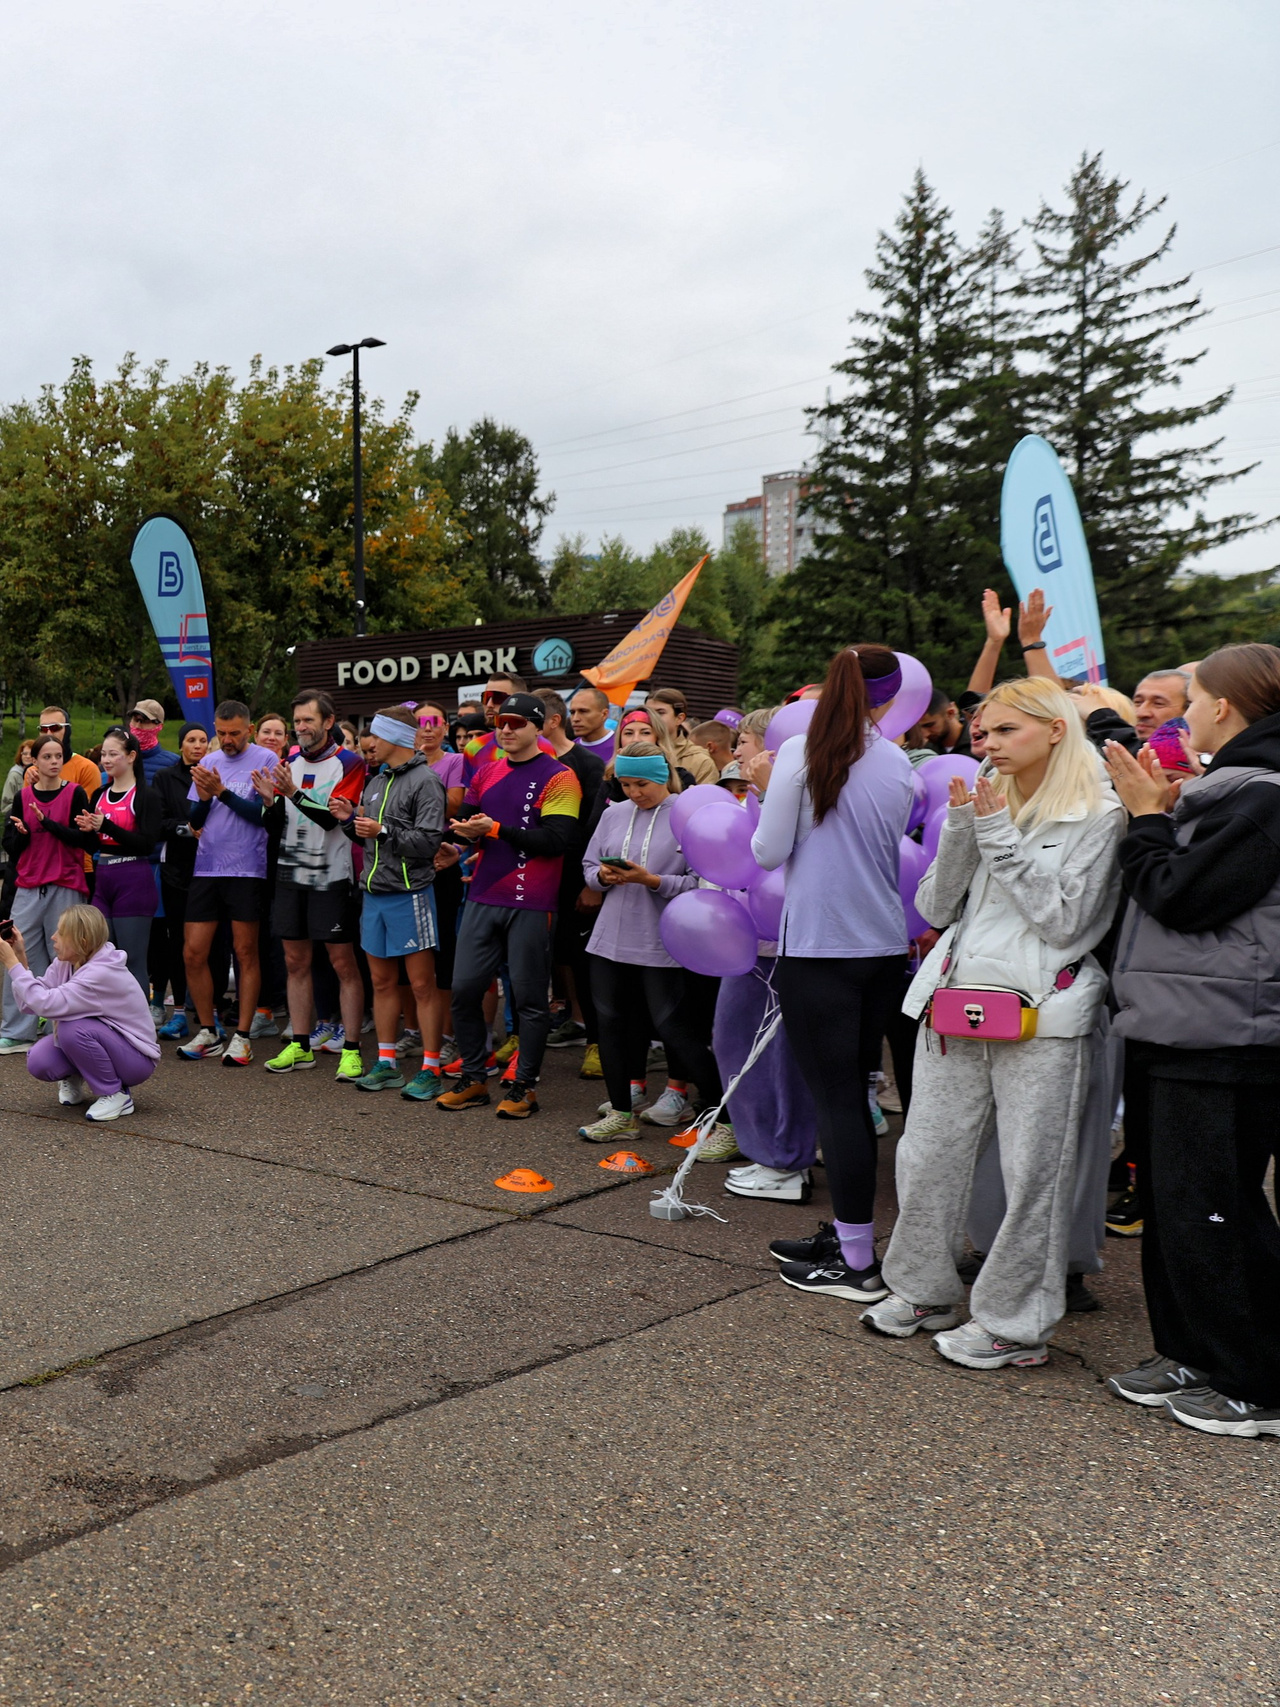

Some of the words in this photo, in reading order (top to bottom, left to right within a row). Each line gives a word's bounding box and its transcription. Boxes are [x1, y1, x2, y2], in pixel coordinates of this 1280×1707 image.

[337, 655, 421, 687] FOOD
[431, 646, 518, 679] PARK
[107, 857, 122, 866] NIKE
